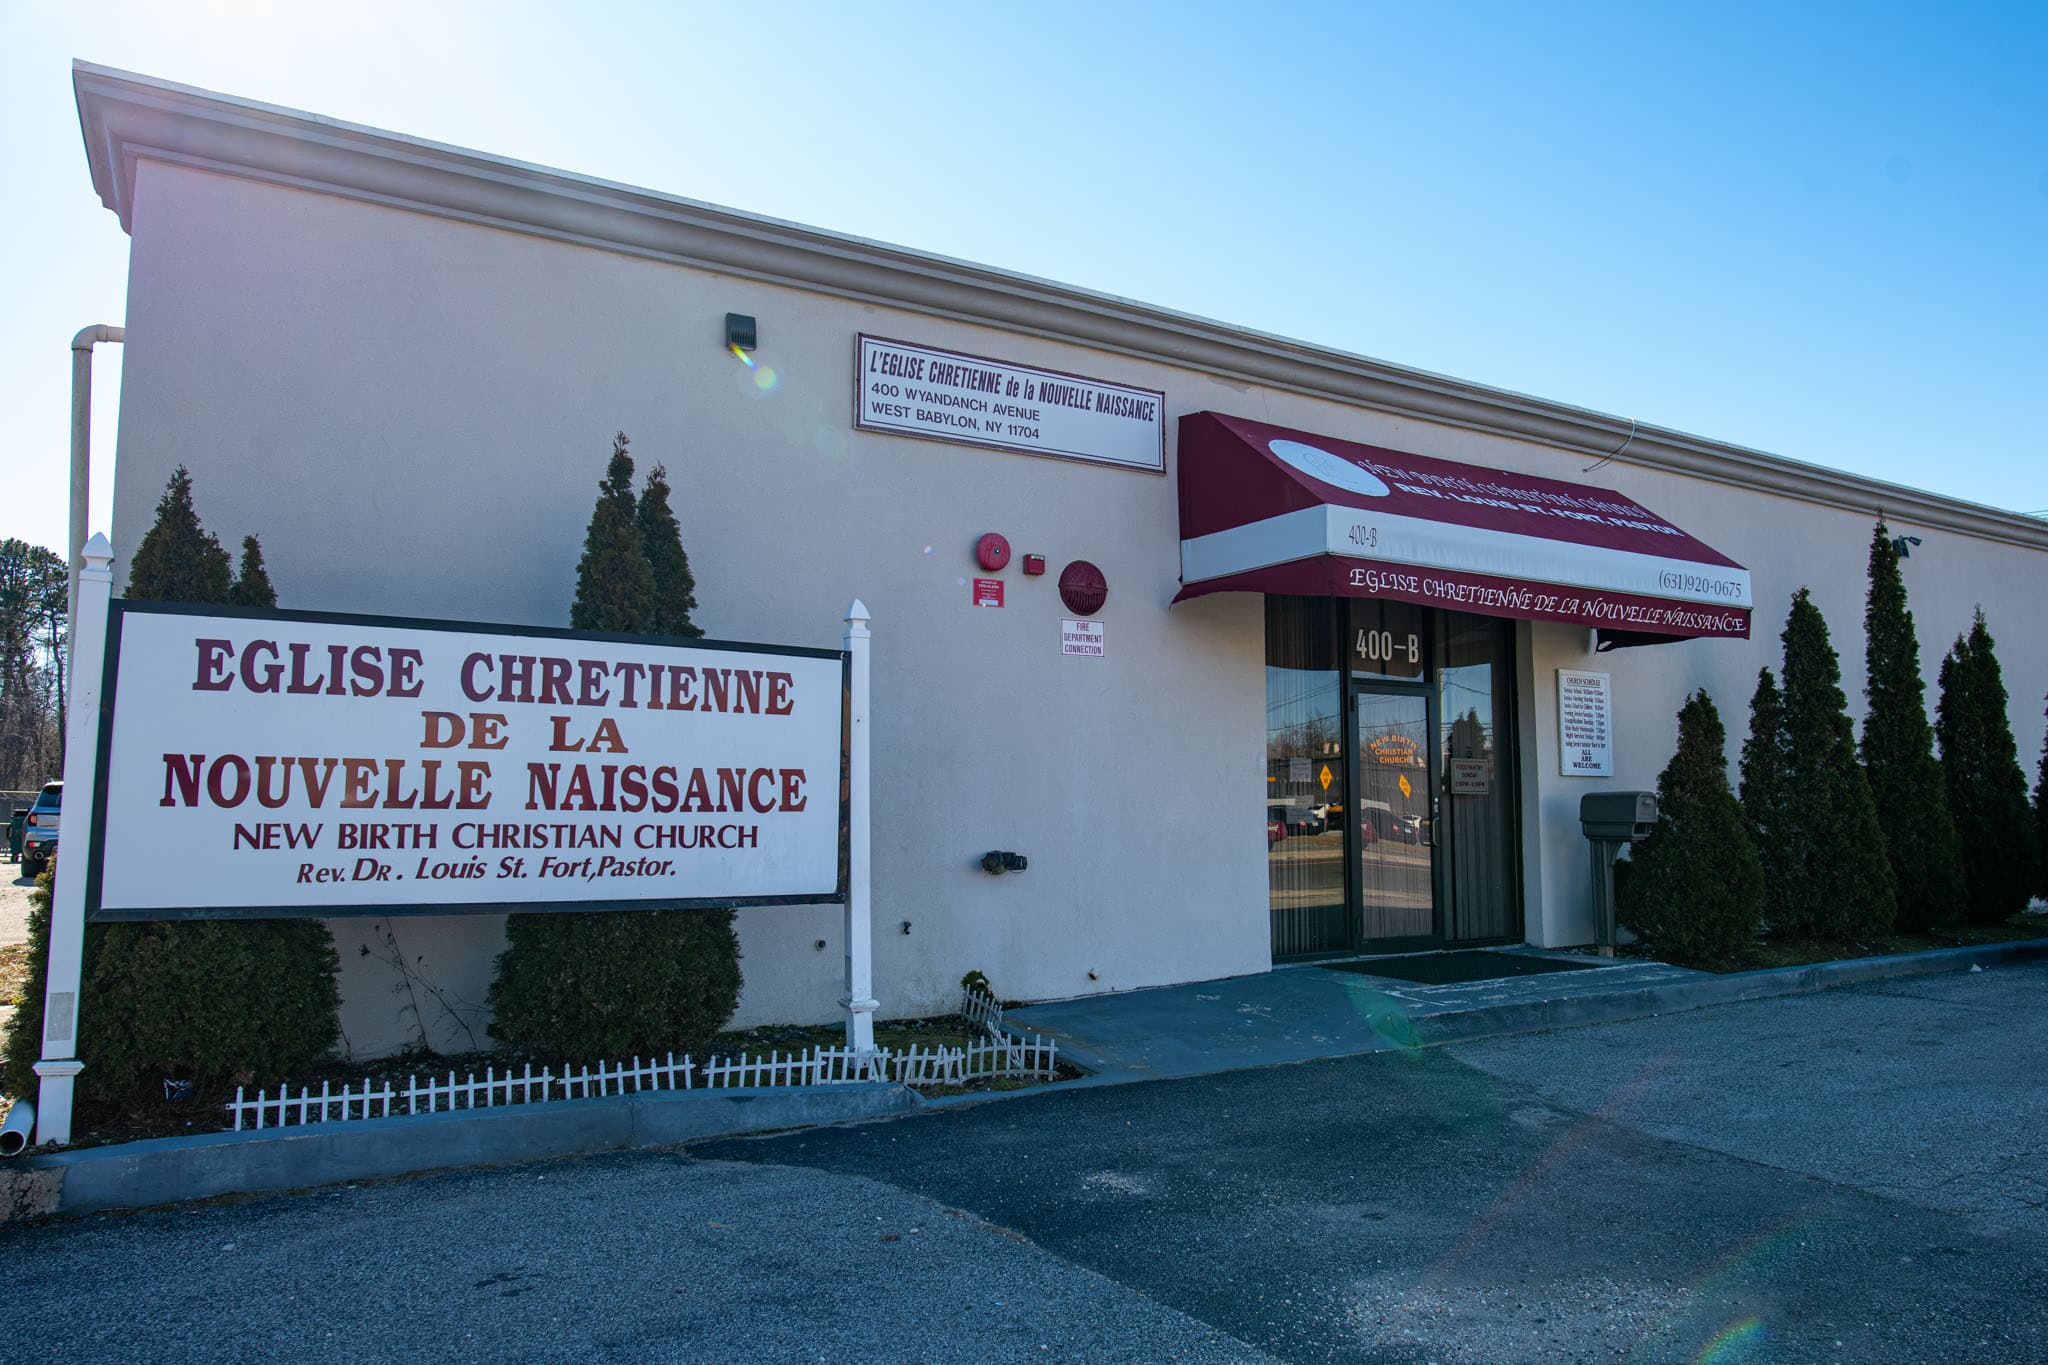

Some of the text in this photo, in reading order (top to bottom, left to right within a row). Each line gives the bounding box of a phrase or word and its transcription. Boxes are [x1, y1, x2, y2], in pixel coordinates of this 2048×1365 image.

[871, 351, 1155, 422] L'EGLISE CHRETIENNE de la NOUVELLE NAISSANCE
[872, 383, 1039, 421] 400 WYANDANCH AVENUE
[872, 402, 1039, 439] WEST BABYLON, NY 11704
[1348, 524, 1378, 548] 400-B
[1658, 570, 1742, 598] (631)920-0675
[1349, 568, 1747, 632] EGLISE CHRETIENNE DE LA NOUVELLE NAISSANCE
[1063, 633, 1102, 643] DEPARTMENT
[1076, 622, 1090, 632] FIRE
[1064, 644, 1102, 655] CONNECTION
[1356, 629, 1419, 664] 400-B
[192, 639, 794, 715] EGLISE CHRETIENNE
[420, 711, 628, 753] DE LA
[1370, 735, 1389, 750] NEW
[1379, 756, 1409, 764] CHURCH
[160, 754, 807, 813] NOUVELLE NAISSANCE
[234, 823, 757, 849] NEW BIRTH CHRISTIAN CHURCH
[297, 864, 345, 883] Rev.
[416, 855, 487, 879] Louis
[497, 856, 527, 878] St.
